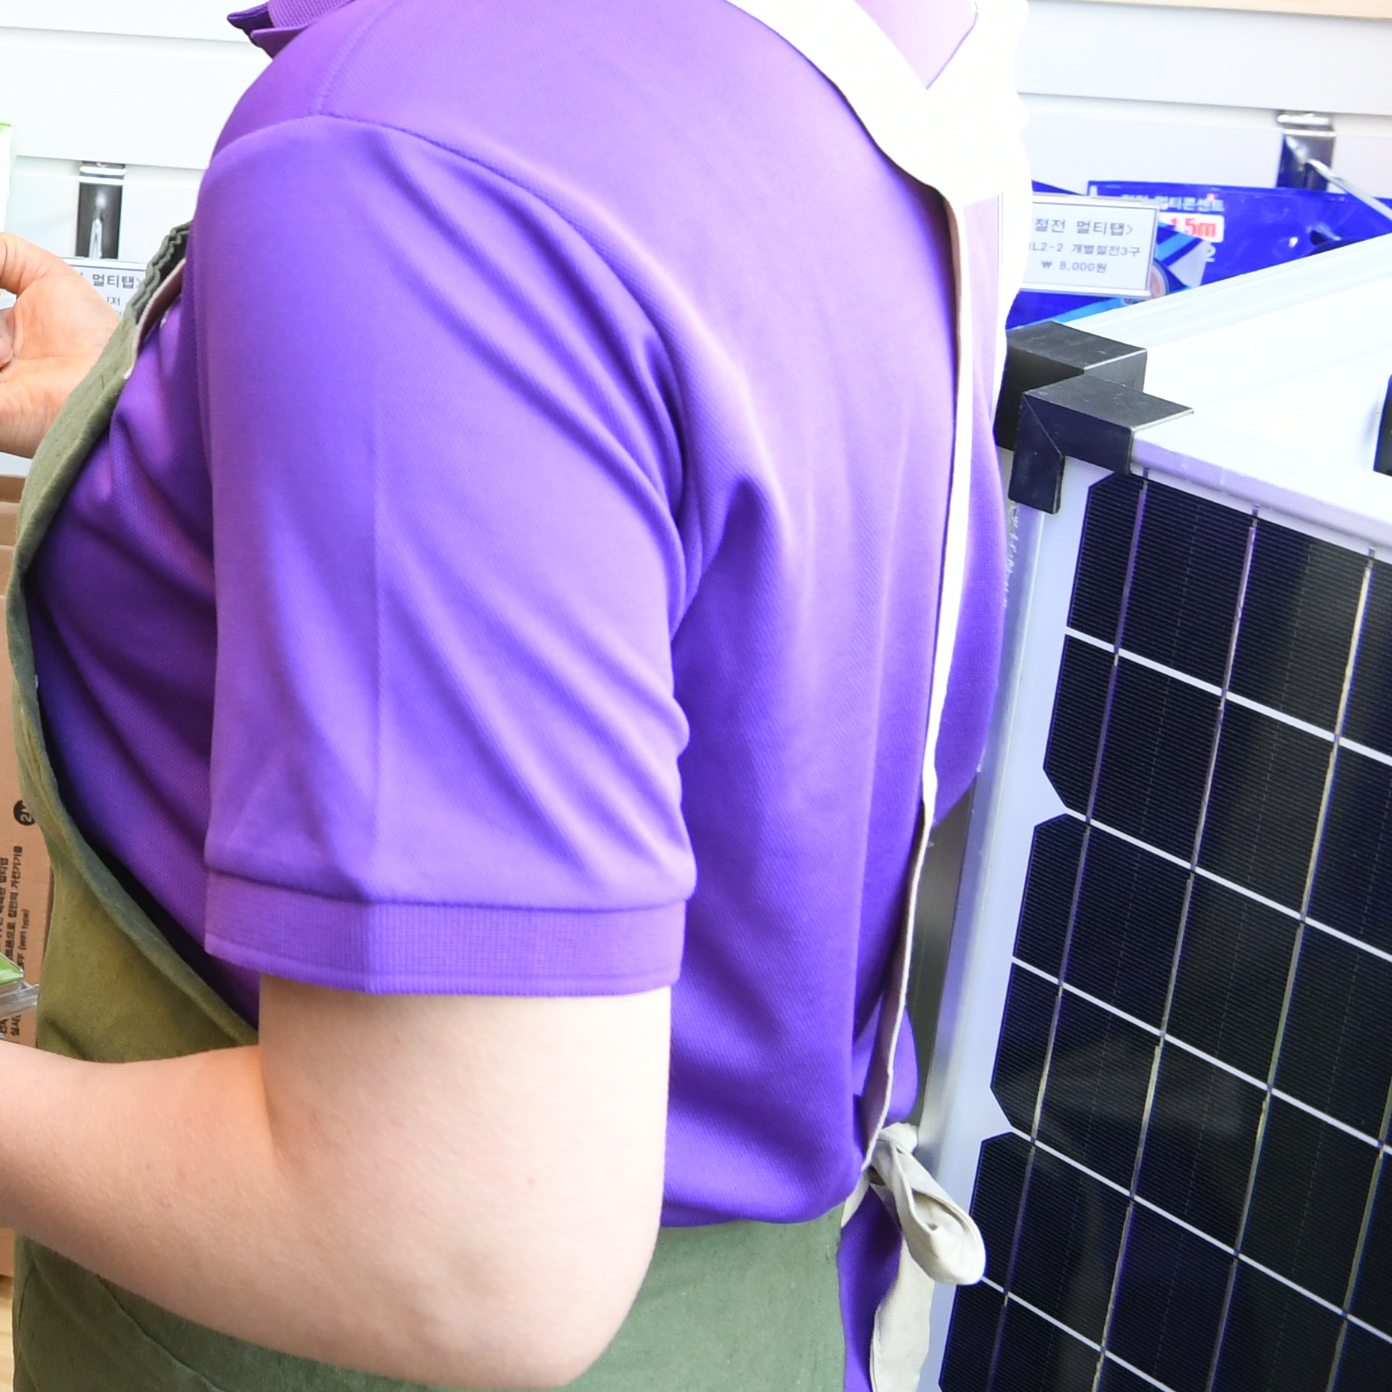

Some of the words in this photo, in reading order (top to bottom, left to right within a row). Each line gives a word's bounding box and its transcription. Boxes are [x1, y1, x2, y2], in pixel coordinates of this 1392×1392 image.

[1076, 218, 1133, 237] 멀티탭>
[1070, 242, 1141, 259] 개별절전3구
[1059, 261, 1107, 274] 8,000원
